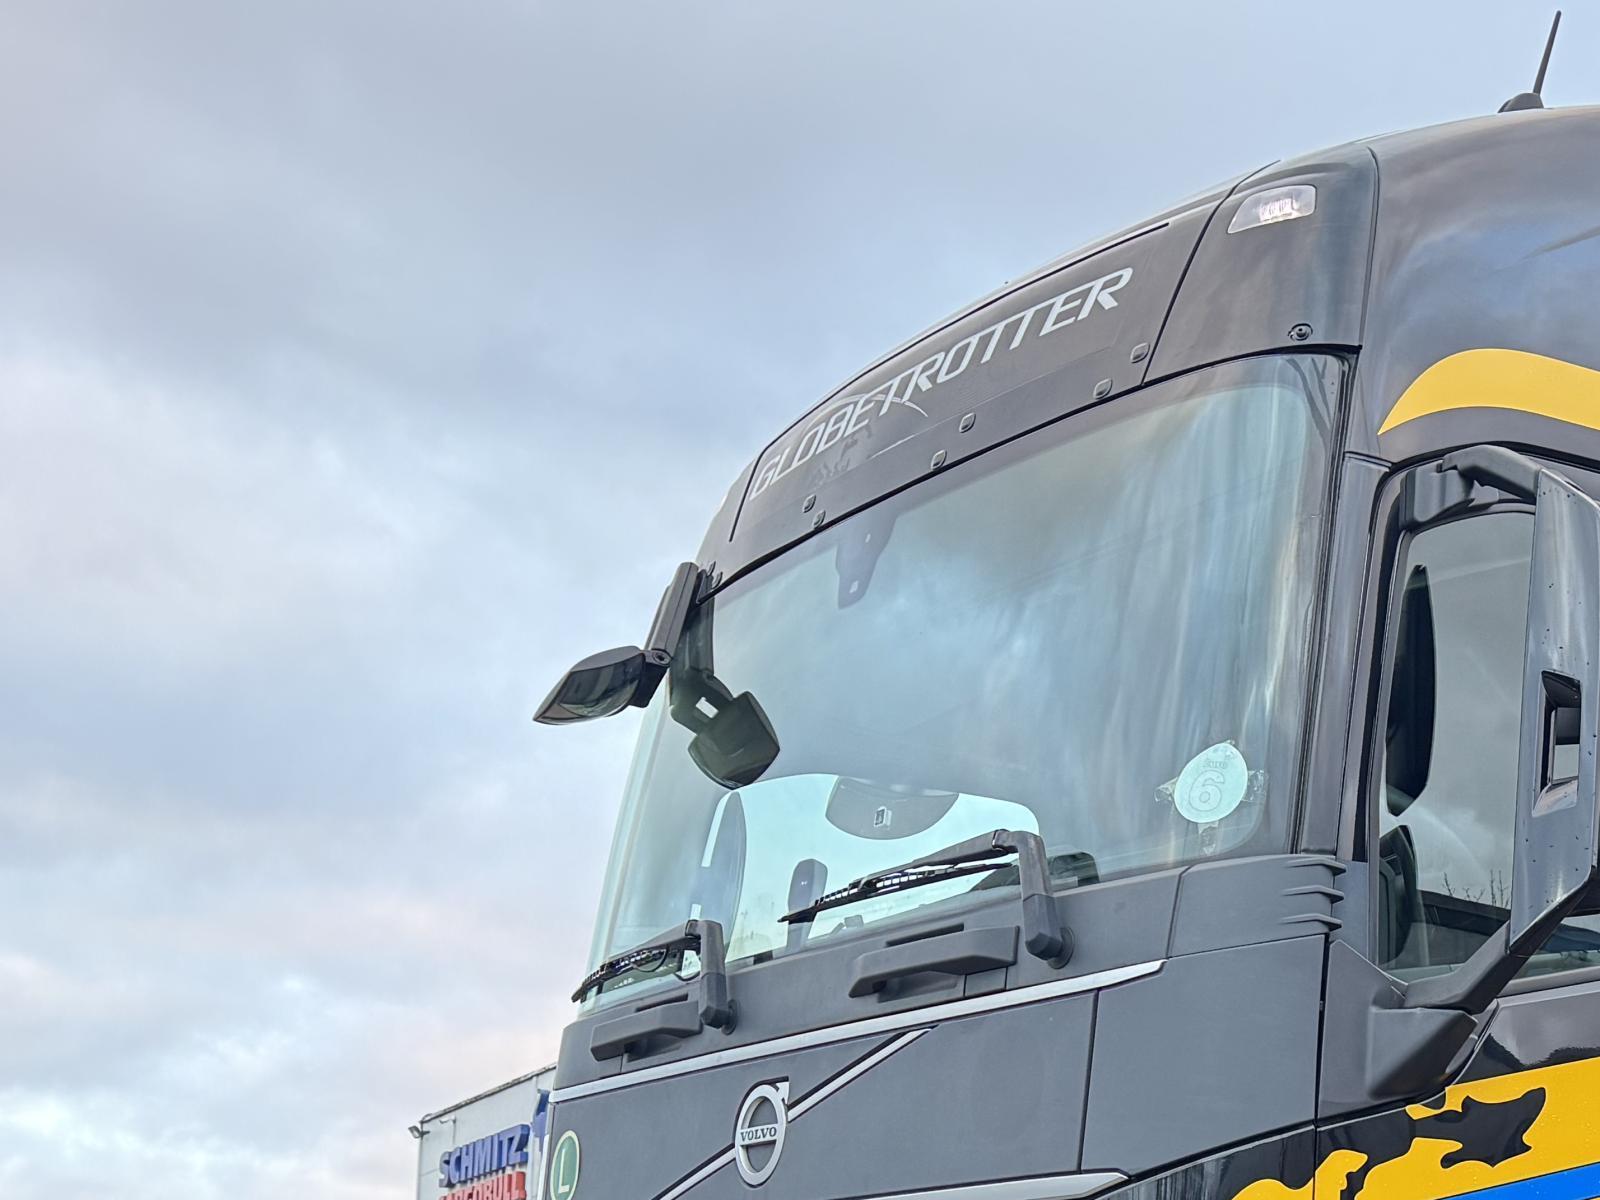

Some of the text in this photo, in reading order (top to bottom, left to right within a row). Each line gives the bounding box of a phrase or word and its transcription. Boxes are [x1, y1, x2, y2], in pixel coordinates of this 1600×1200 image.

[749, 266, 1134, 501] GLOBETROTTER
[438, 1124, 531, 1188] SCHMITZ
[739, 1125, 778, 1143] VOLVO
[557, 1148, 571, 1194] L
